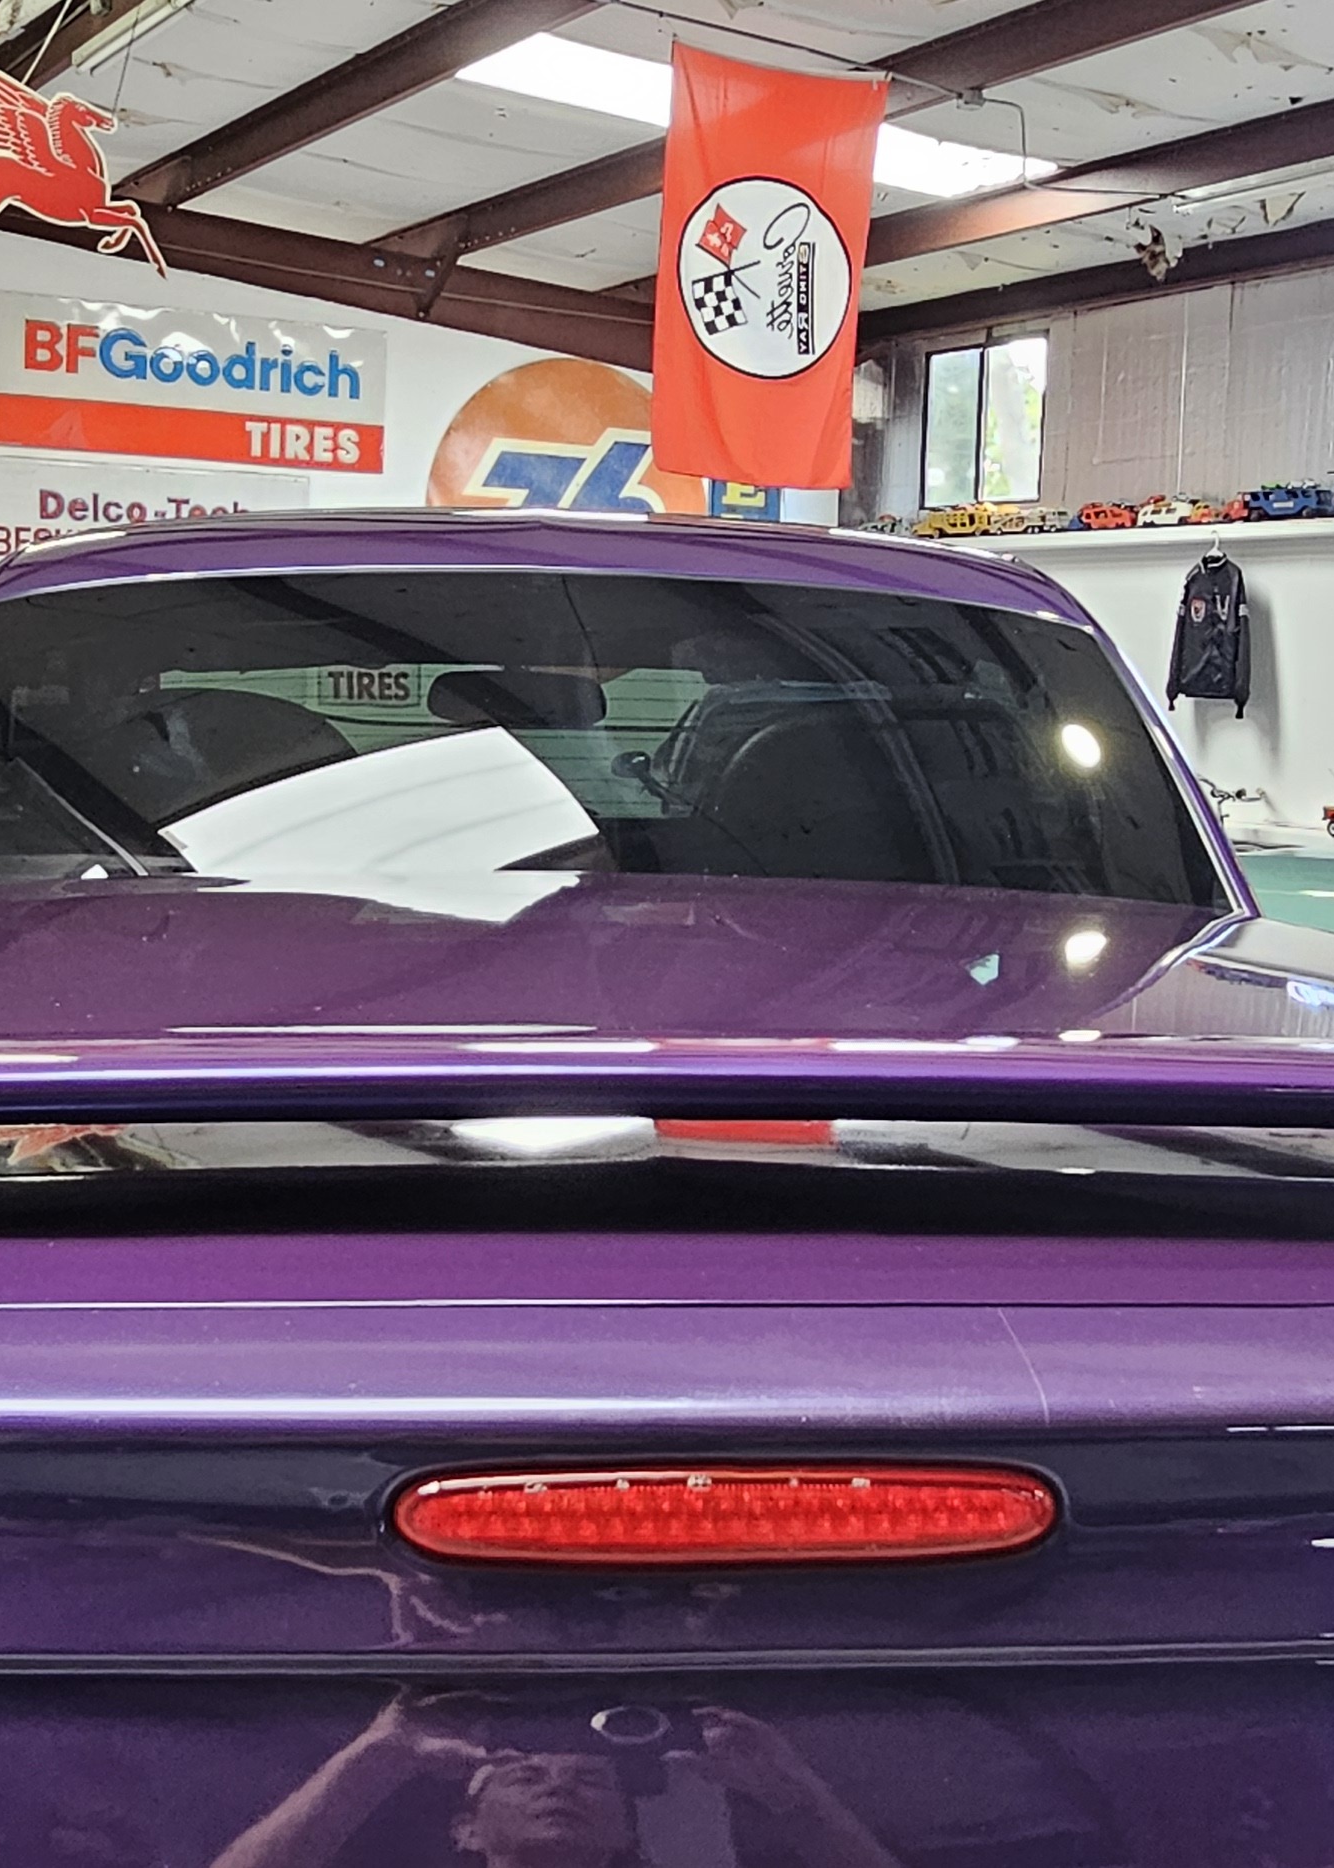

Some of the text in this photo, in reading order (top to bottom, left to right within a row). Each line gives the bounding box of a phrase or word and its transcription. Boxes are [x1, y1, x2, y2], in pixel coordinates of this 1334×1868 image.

[24, 318, 360, 400] BFGoodrich
[245, 421, 360, 464] TIRES
[328, 669, 410, 702] TIRES
